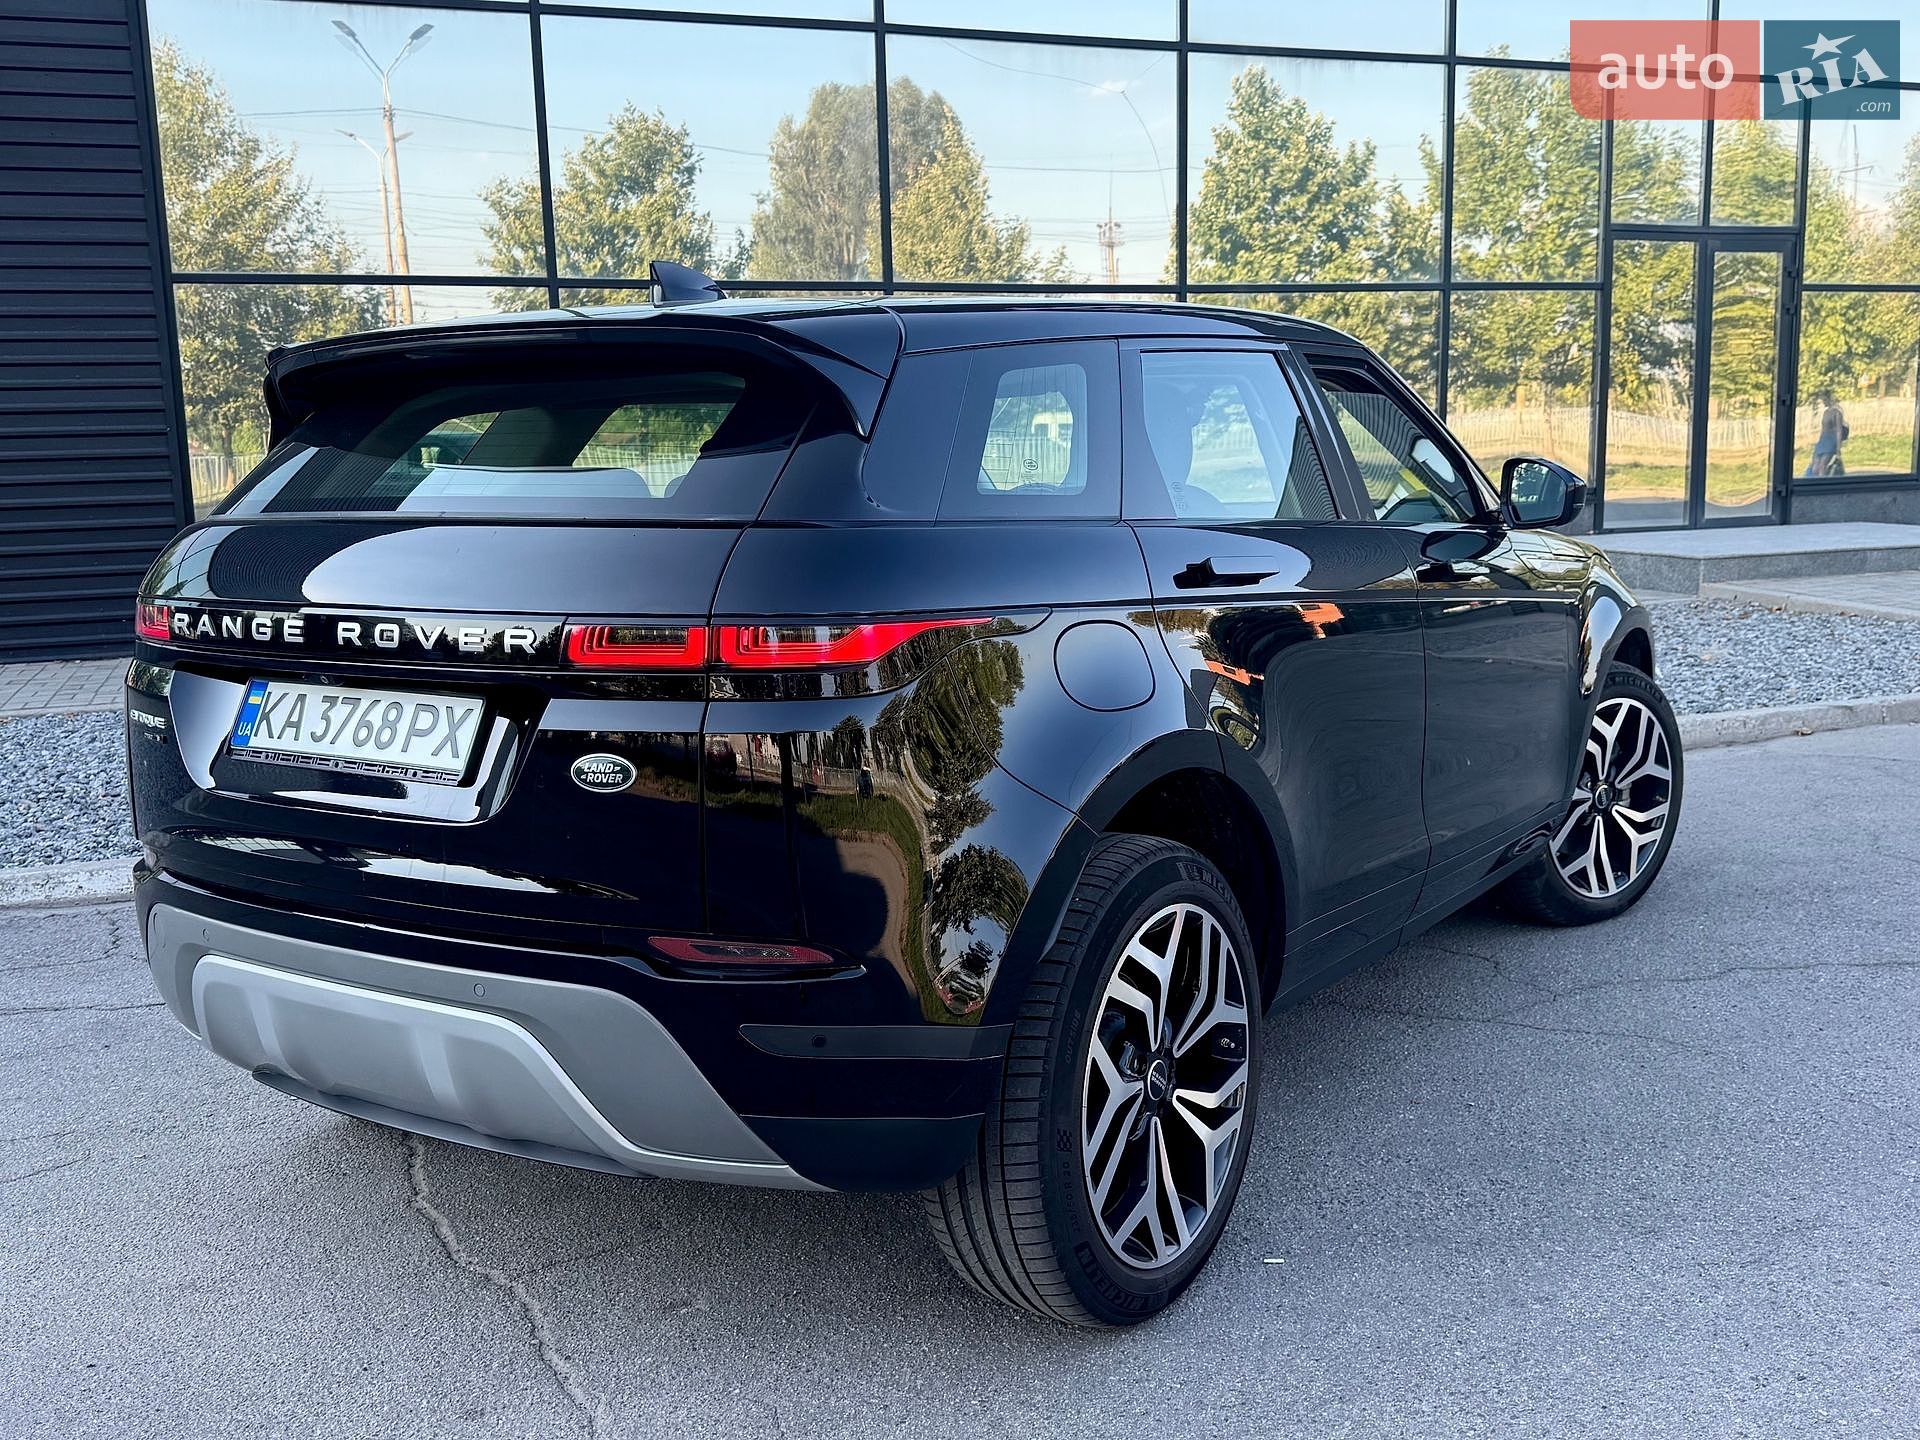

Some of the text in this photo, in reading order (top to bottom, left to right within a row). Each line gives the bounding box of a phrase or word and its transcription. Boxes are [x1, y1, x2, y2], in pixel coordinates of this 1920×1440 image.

[173, 611, 538, 654] RANGE ROVER
[237, 721, 251, 737] UA
[253, 691, 474, 759] KA 3768 PX
[583, 762, 614, 773] LAND
[586, 772, 623, 783] ROVER
